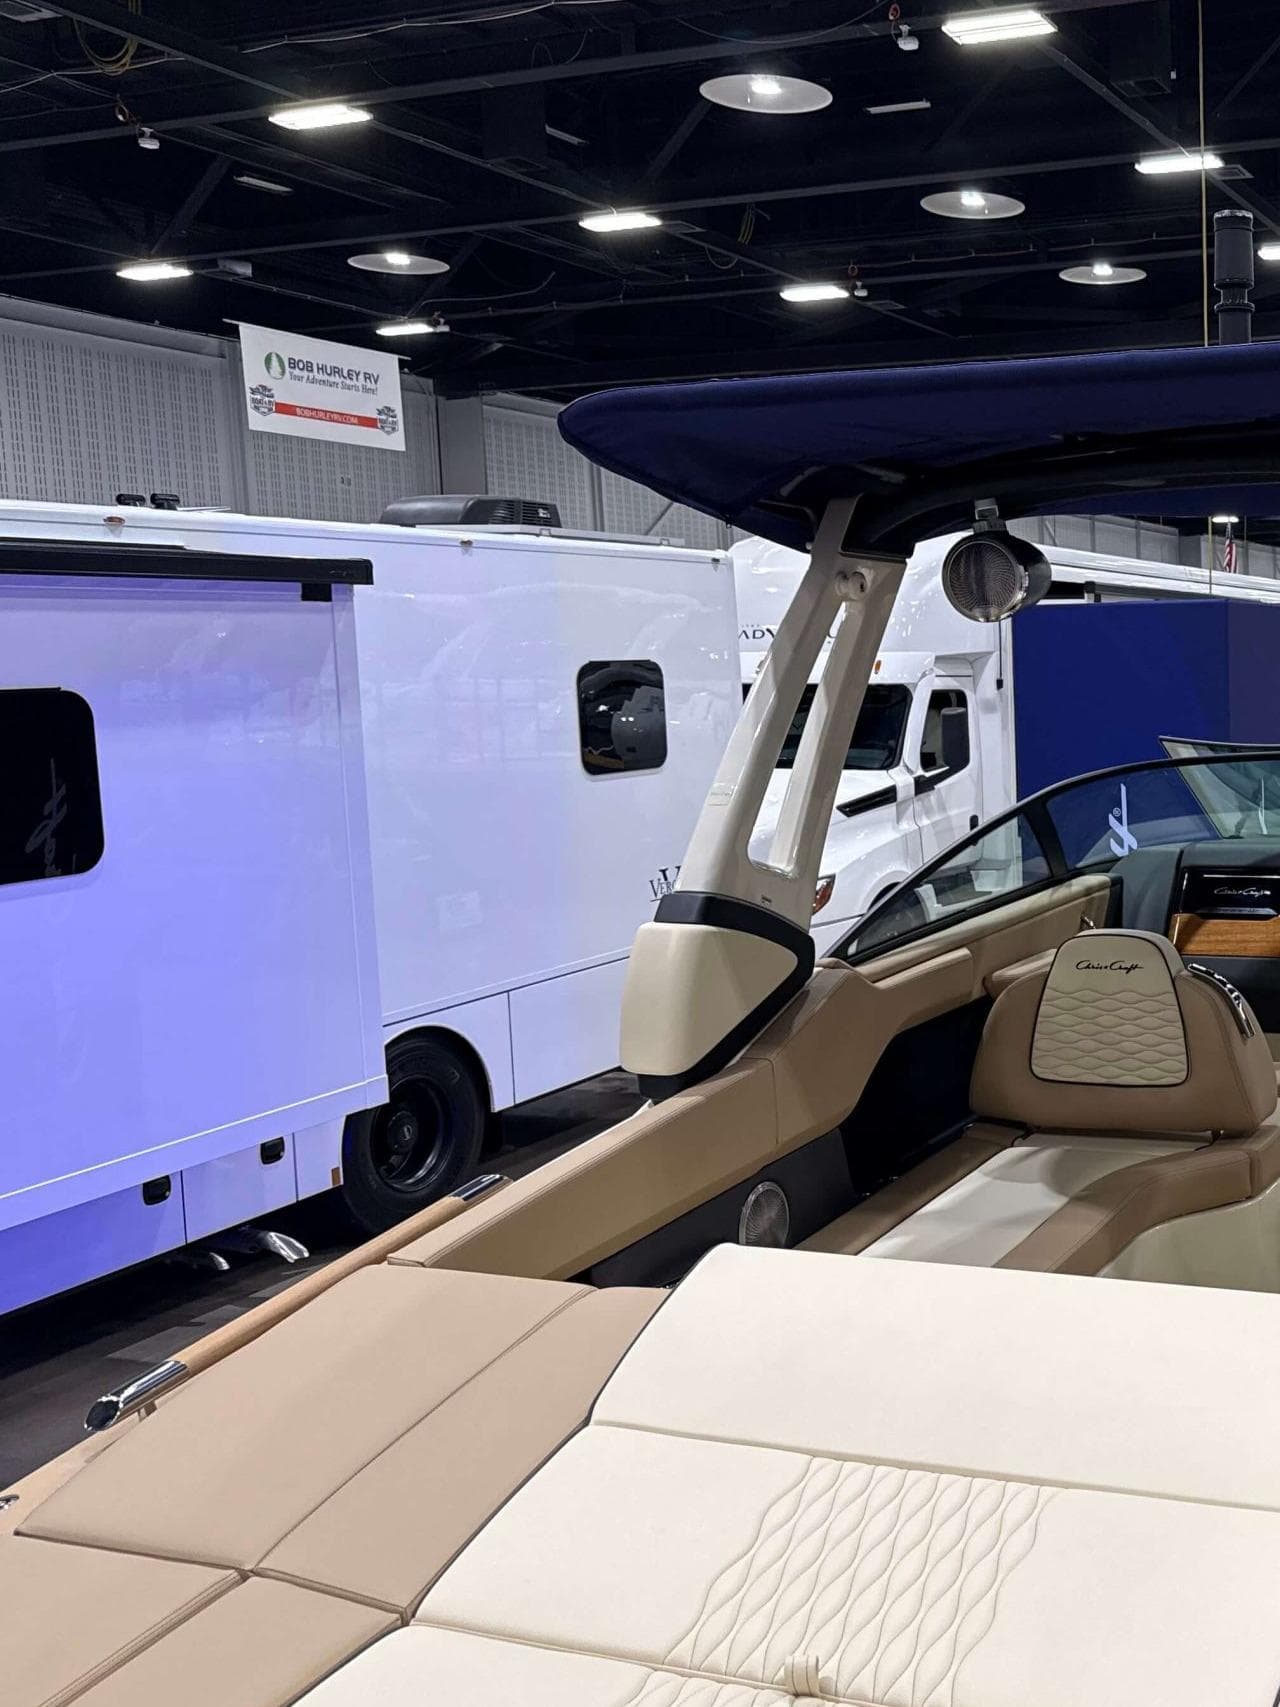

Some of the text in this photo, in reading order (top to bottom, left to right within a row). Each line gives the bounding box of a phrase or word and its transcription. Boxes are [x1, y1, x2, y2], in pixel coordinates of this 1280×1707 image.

[288, 357, 380, 385] BOB HURLEY RV
[289, 371, 304, 382] Your
[306, 374, 340, 389] Adventure
[341, 380, 360, 393] Starts
[296, 407, 359, 424] BOBHURLEYRV.COM
